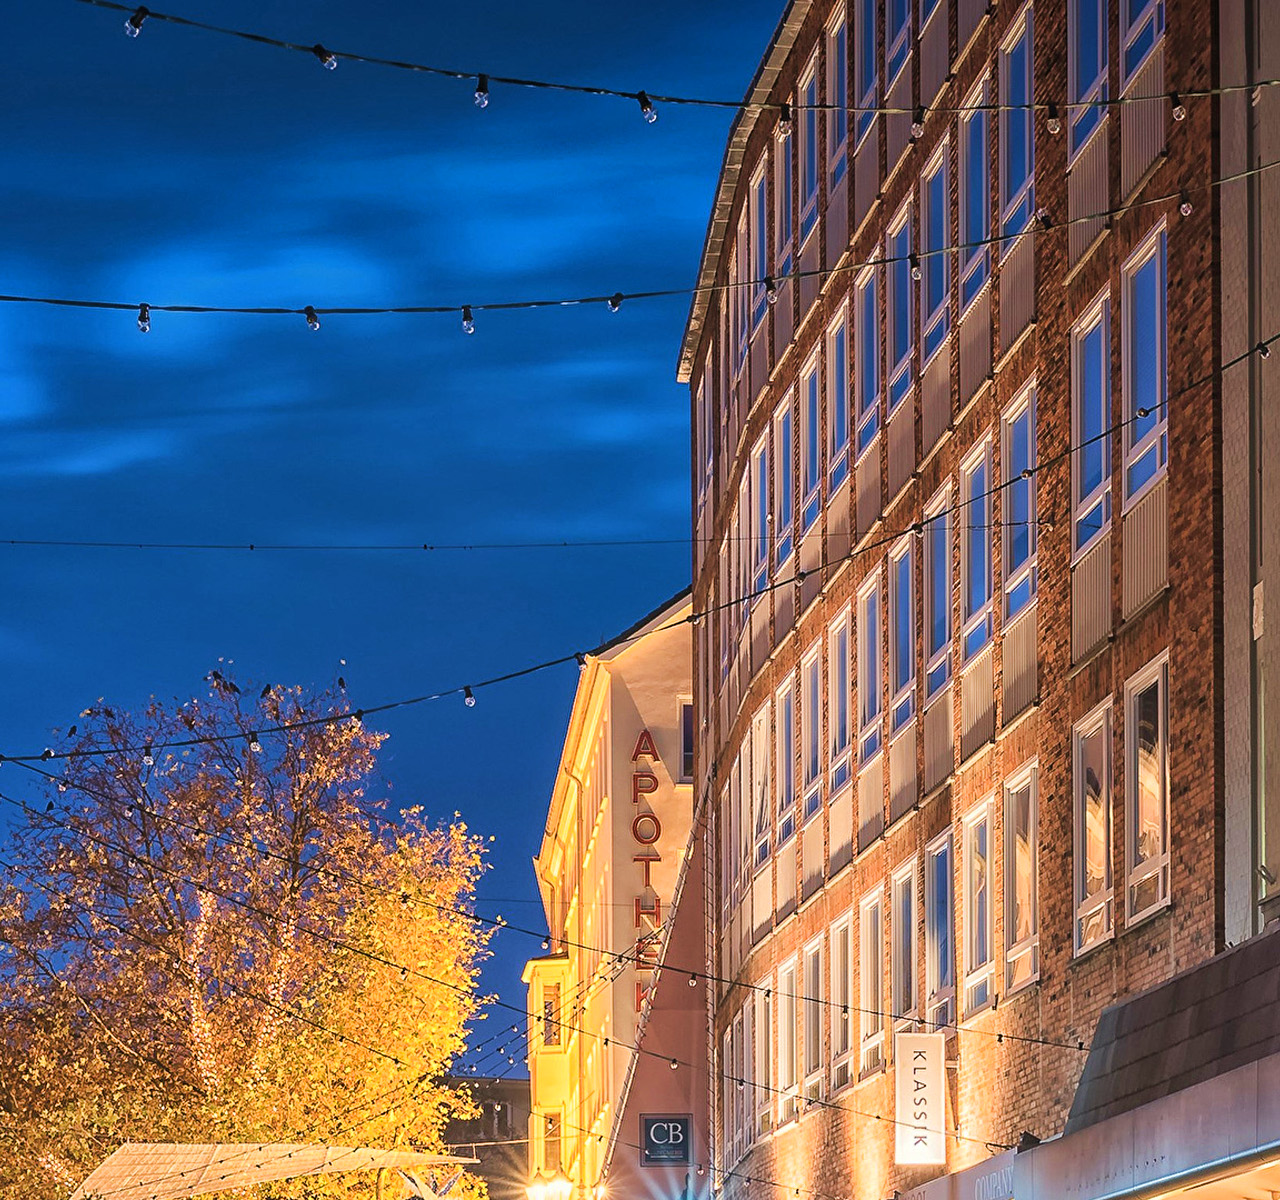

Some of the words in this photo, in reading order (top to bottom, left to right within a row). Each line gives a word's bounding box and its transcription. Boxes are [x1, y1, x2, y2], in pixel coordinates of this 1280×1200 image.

[631, 729, 662, 1013] APOTHEK
[649, 1122, 684, 1144] CB
[913, 1050, 928, 1146] KLASSIK
